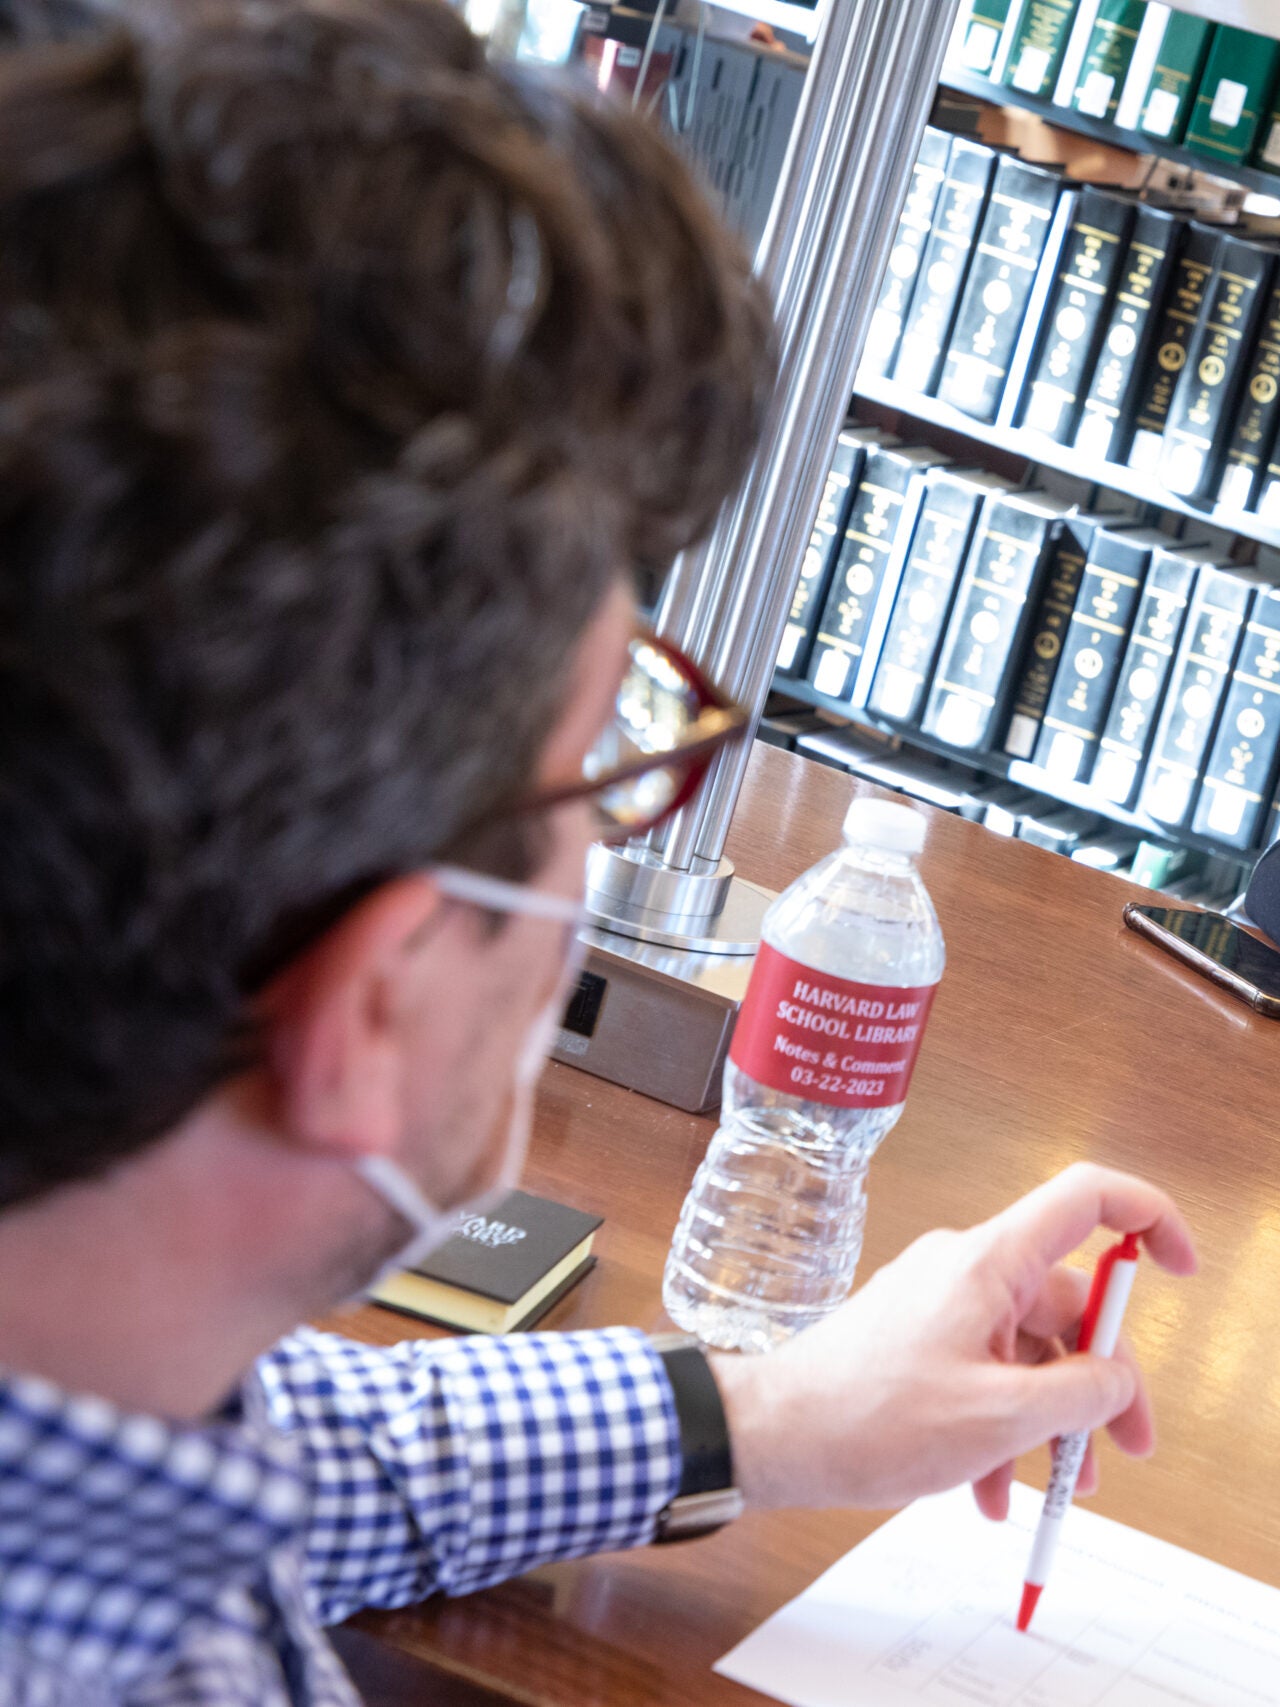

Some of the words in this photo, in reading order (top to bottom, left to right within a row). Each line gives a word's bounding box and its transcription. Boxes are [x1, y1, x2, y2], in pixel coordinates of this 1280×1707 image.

[793, 981, 884, 1019] HARVARD
[886, 1002, 919, 1021] LAW
[776, 1001, 851, 1039] SCHOOL
[855, 1023, 919, 1042] LIBRARY
[774, 1035, 821, 1064] Notes
[822, 1052, 836, 1068] &
[790, 1067, 886, 1096] 03-22-2023
